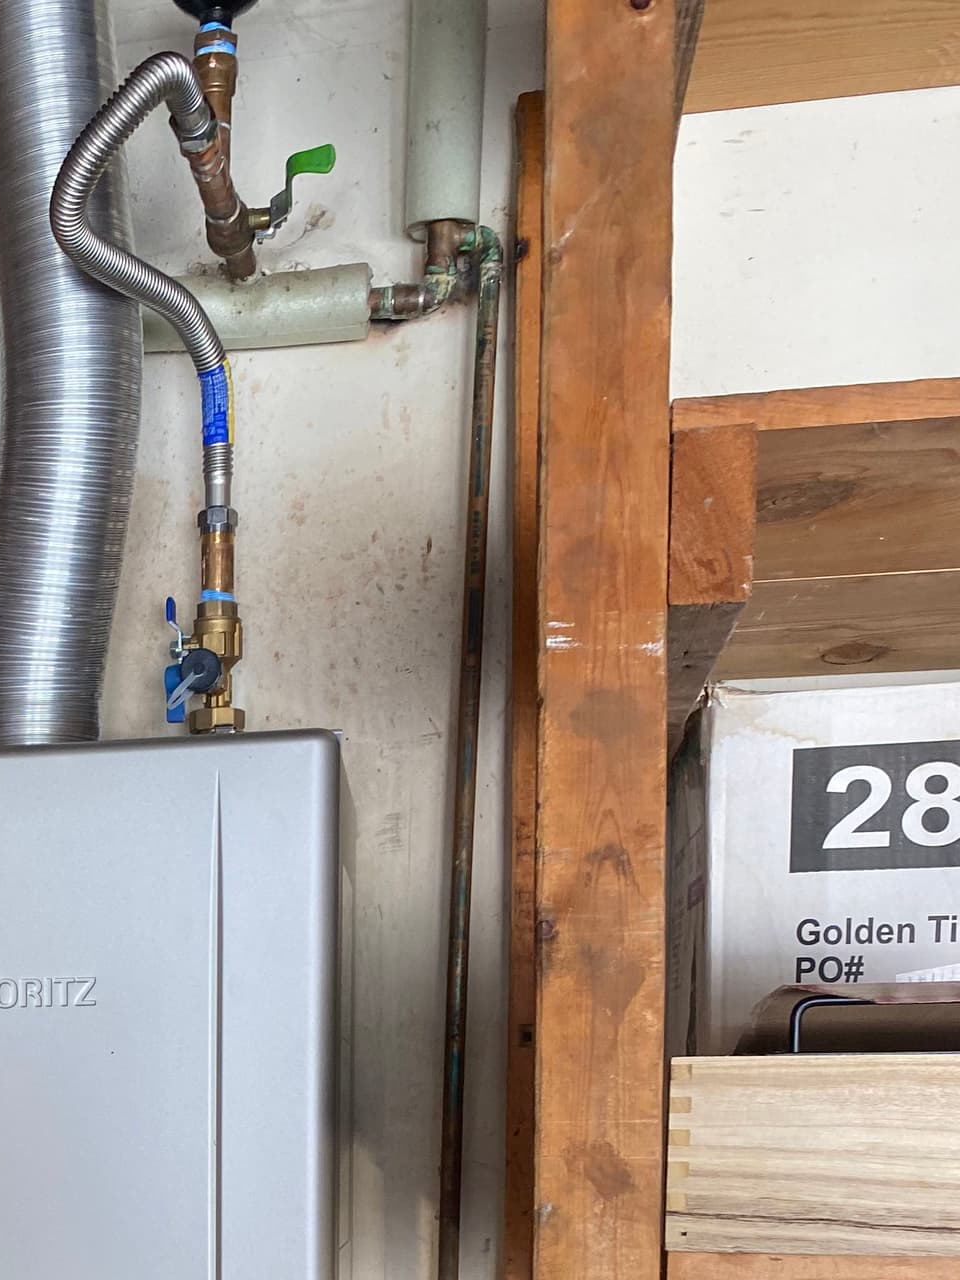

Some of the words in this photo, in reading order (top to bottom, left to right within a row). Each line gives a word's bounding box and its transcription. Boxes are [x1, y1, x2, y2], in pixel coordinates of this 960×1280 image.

[822, 761, 960, 849] 28
[796, 917, 916, 946] Golden
[928, 914, 958, 944] Ti
[796, 955, 865, 984] PO#
